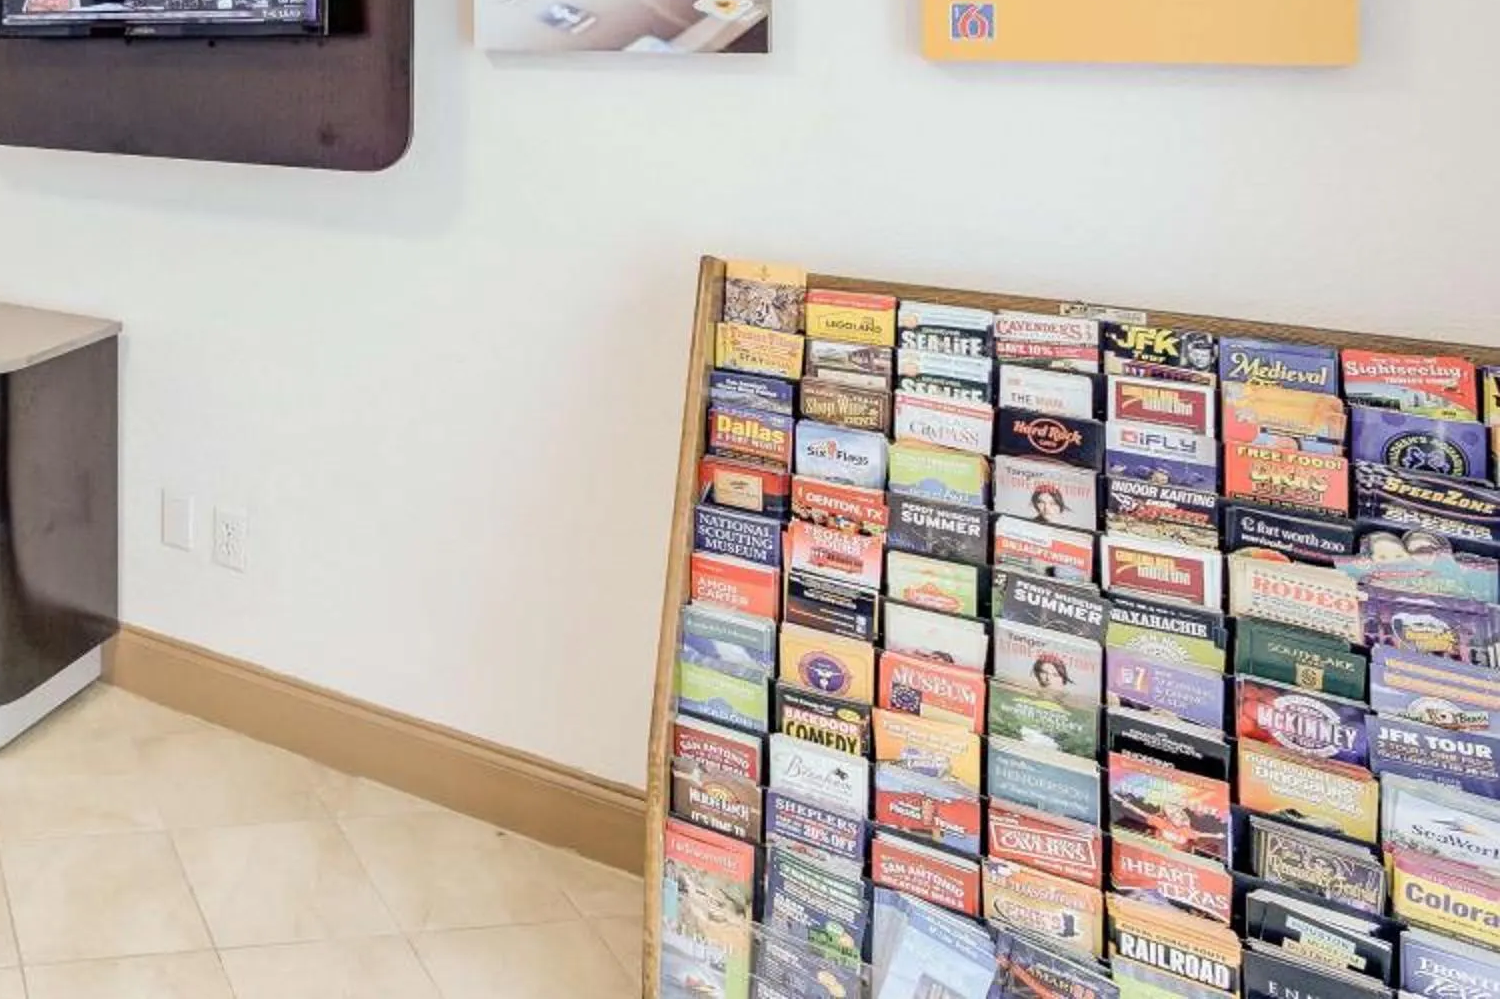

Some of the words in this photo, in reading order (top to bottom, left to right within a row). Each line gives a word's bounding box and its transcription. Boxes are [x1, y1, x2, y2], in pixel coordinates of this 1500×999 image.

[825, 318, 883, 334] LEGOLAND
[1028, 345, 1053, 356] 10%
[1116, 325, 1180, 356] JFK
[1228, 352, 1328, 386] Medieval
[804, 398, 836, 418] Shop
[1010, 392, 1032, 404] THE
[717, 415, 784, 444] Dallas
[1013, 420, 1047, 438] Hard
[1048, 426, 1083, 445] Rock
[1140, 433, 1196, 451] iFLY
[807, 446, 826, 458] Six
[836, 450, 869, 466] Flags
[1237, 447, 1282, 462] FREE
[1111, 480, 1158, 498] INDOOR
[1160, 489, 1215, 508] KARTING
[699, 514, 773, 537] NATIONAL
[867, 505, 882, 520] TX
[901, 511, 981, 538] SUMMER
[700, 526, 774, 550] SCOUTING
[705, 538, 767, 561] MUSEUM
[1257, 520, 1280, 535] fort
[1282, 527, 1319, 547] worth
[1319, 538, 1345, 553] zoo
[1054, 591, 1103, 611] MUSEUM
[1251, 574, 1356, 612] RODEO
[1013, 588, 1103, 626] SUMMER
[1110, 608, 1207, 637] WAXAHACHIE
[891, 668, 977, 705] MUSEUM
[784, 705, 859, 735] BACKDOOR
[786, 719, 859, 755] COMEDY
[1377, 726, 1420, 746] JFK
[1426, 736, 1494, 759] TOUR
[703, 743, 750, 768] ANTONIO
[776, 799, 858, 836] SHEPLERS
[832, 830, 858, 851] OFF
[881, 861, 907, 875] SAN
[908, 866, 965, 899] ANTONIO
[1158, 880, 1229, 912] TEXAS
[1121, 931, 1231, 990] RAILROAD
